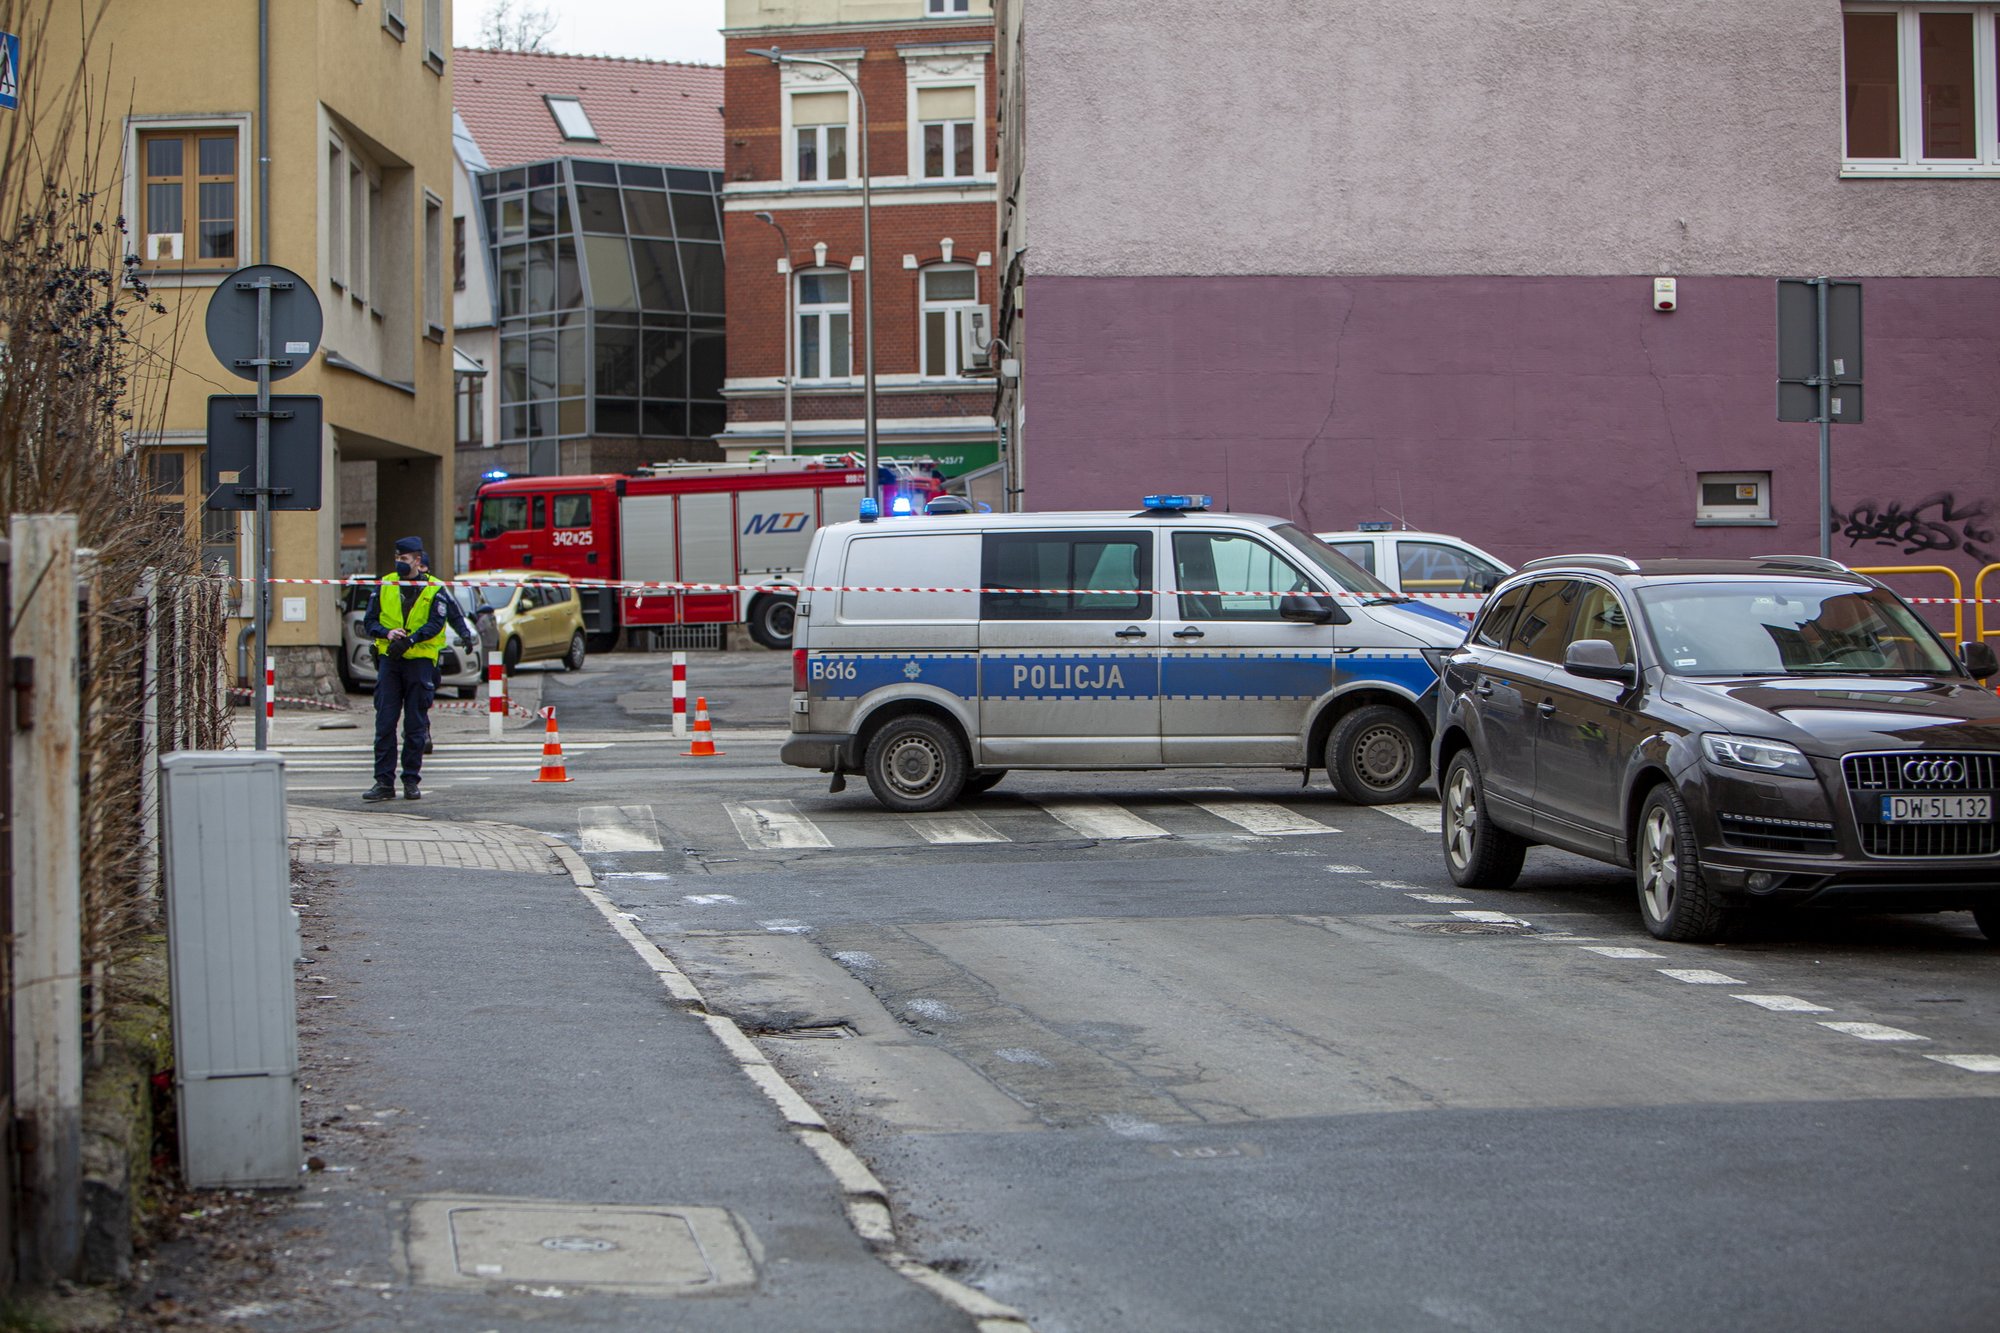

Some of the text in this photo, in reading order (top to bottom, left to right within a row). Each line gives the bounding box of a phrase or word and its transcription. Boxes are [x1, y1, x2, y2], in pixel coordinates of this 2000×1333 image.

[812, 661, 857, 680] B616
[1013, 664, 1125, 689] POLICJA
[1894, 798, 1988, 818] DW 5L132
